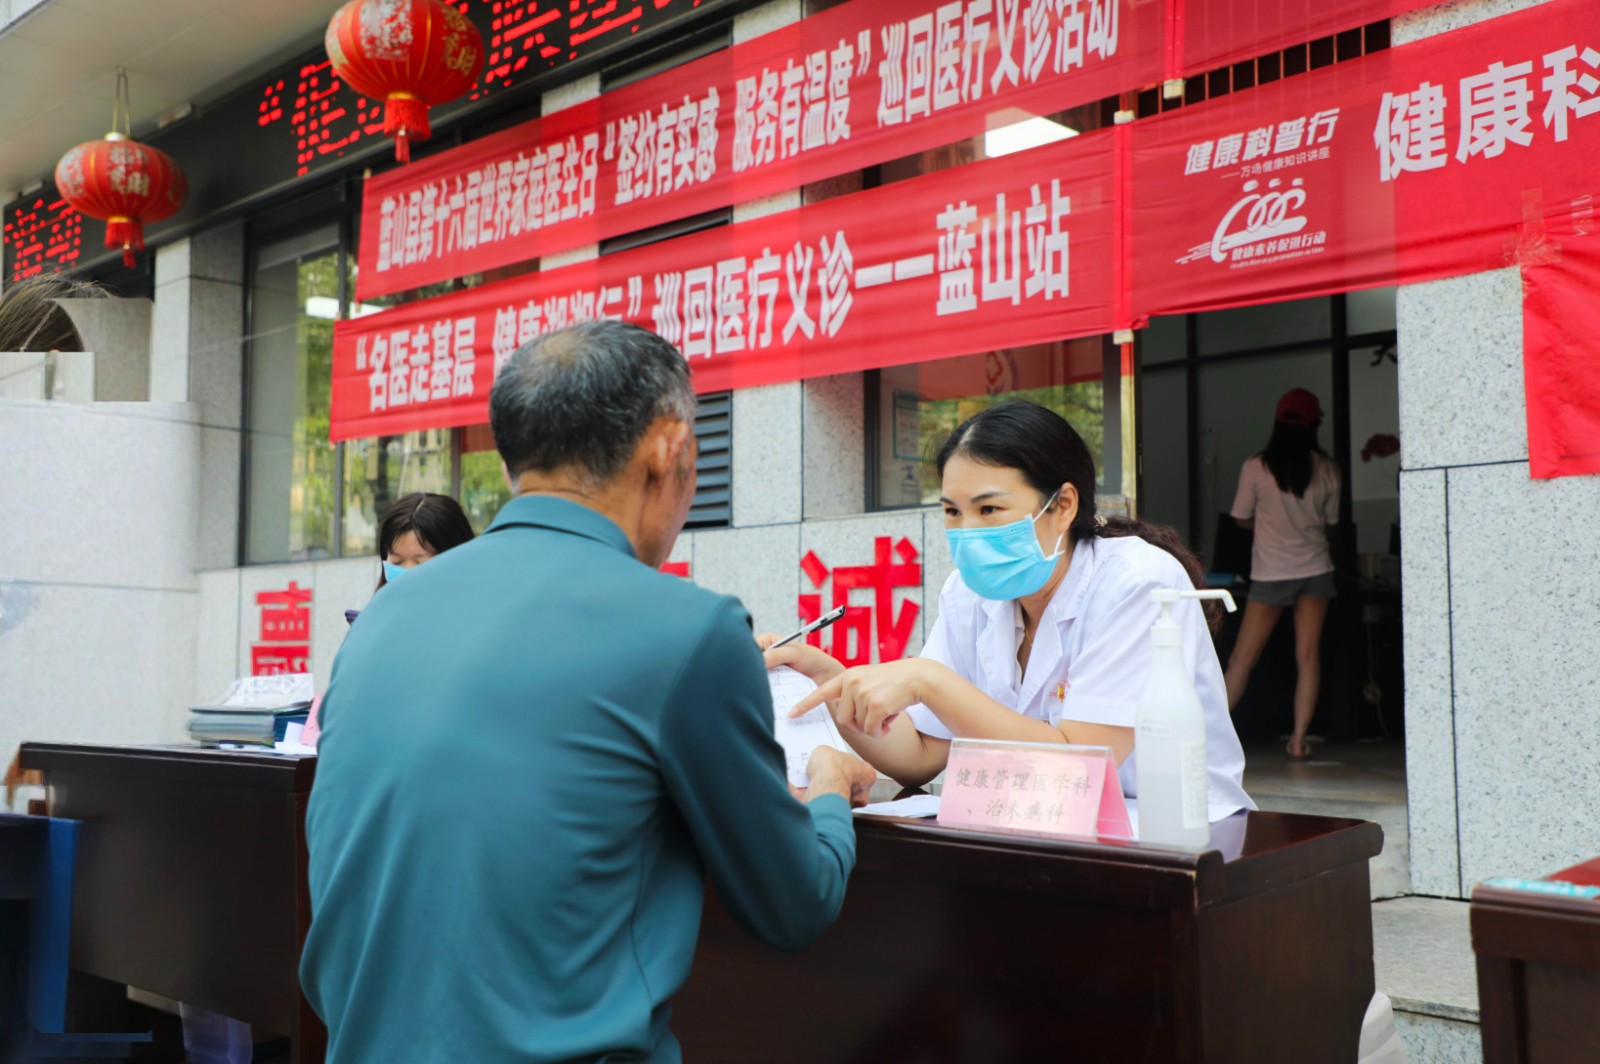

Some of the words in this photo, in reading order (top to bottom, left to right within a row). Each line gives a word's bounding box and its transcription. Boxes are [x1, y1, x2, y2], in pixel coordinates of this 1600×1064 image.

[1184, 107, 1340, 176] 健康科普行
[1373, 44, 1600, 182] 健康科
[798, 536, 921, 668] 诚
[955, 767, 1092, 798] 健康管理医学科
